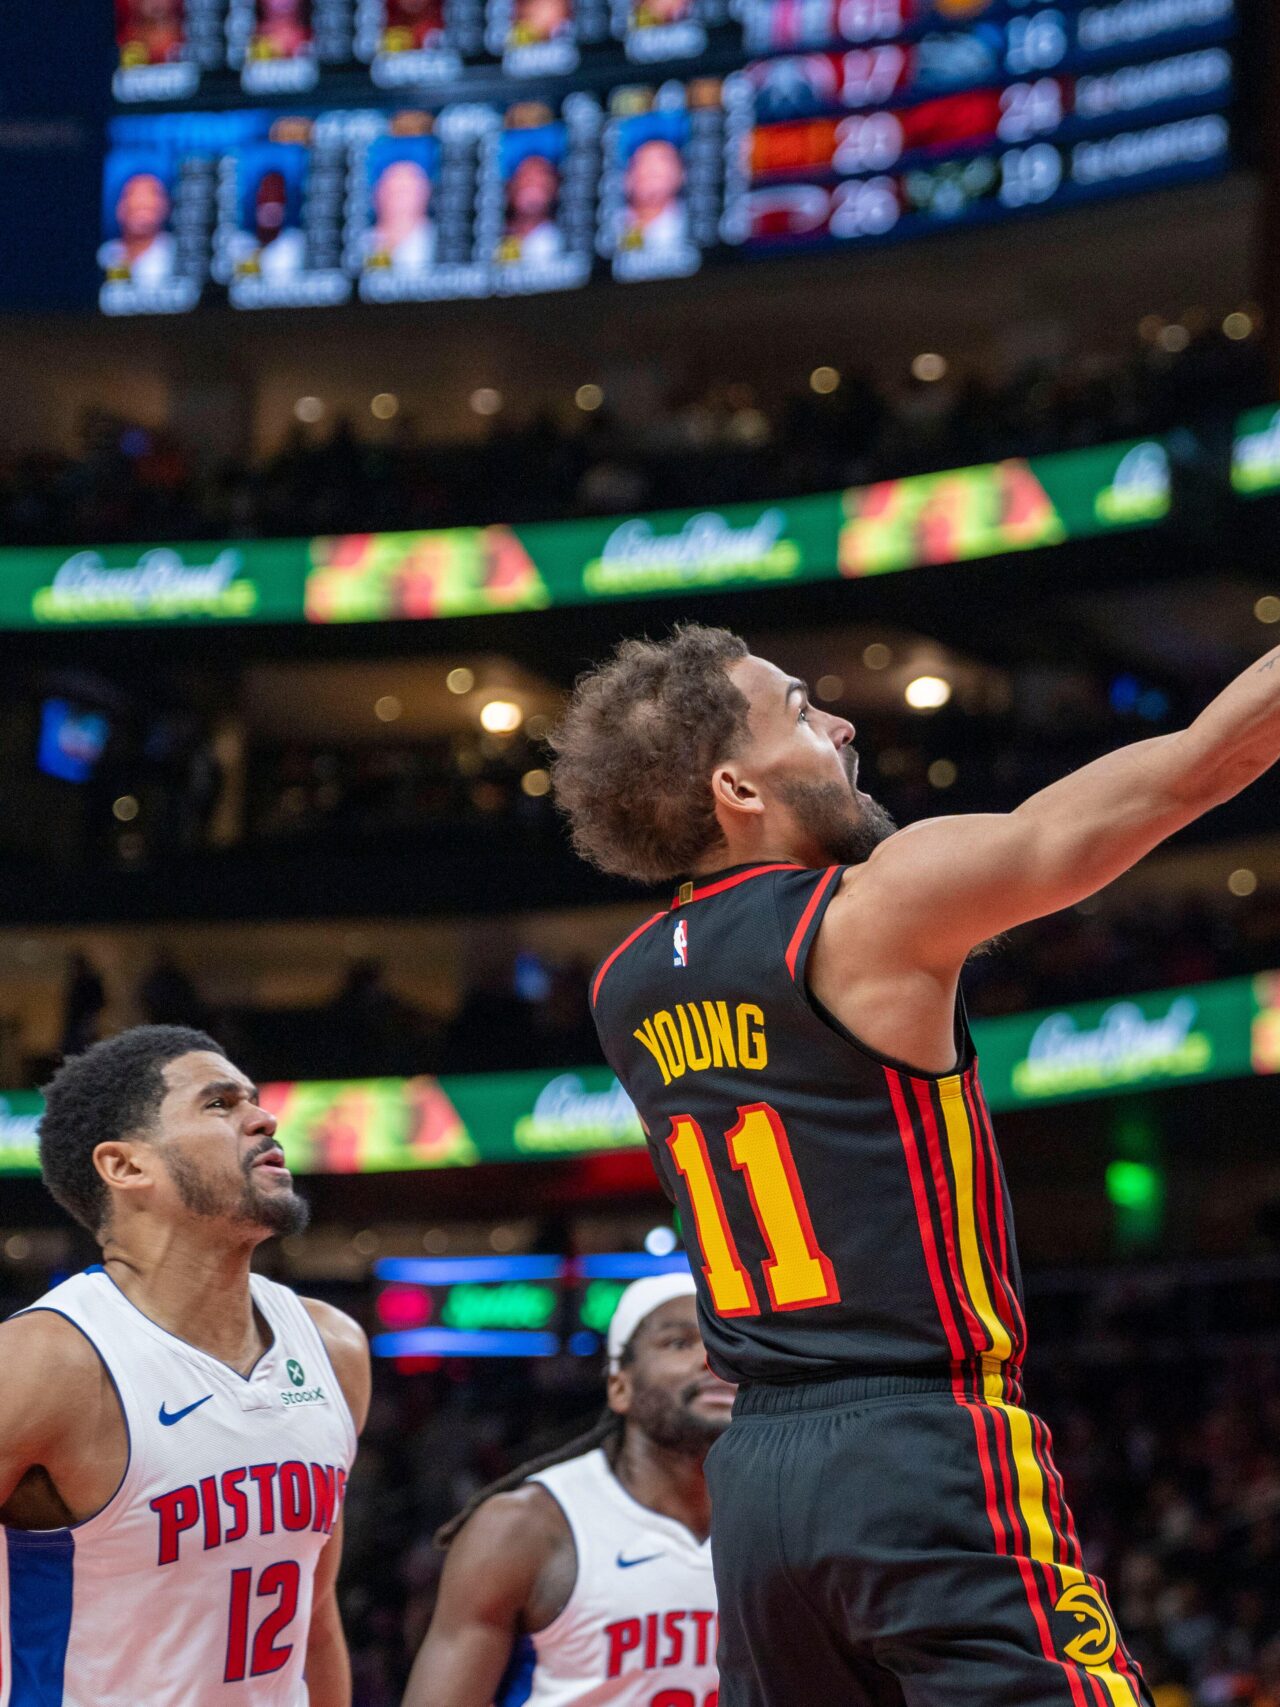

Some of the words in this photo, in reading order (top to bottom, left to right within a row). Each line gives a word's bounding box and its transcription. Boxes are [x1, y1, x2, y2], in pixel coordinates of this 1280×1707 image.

[633, 1000, 768, 1086] YOUNG
[665, 1102, 842, 1319] 11
[224, 1559, 300, 1684] 12
[602, 1608, 719, 1681] PIST
